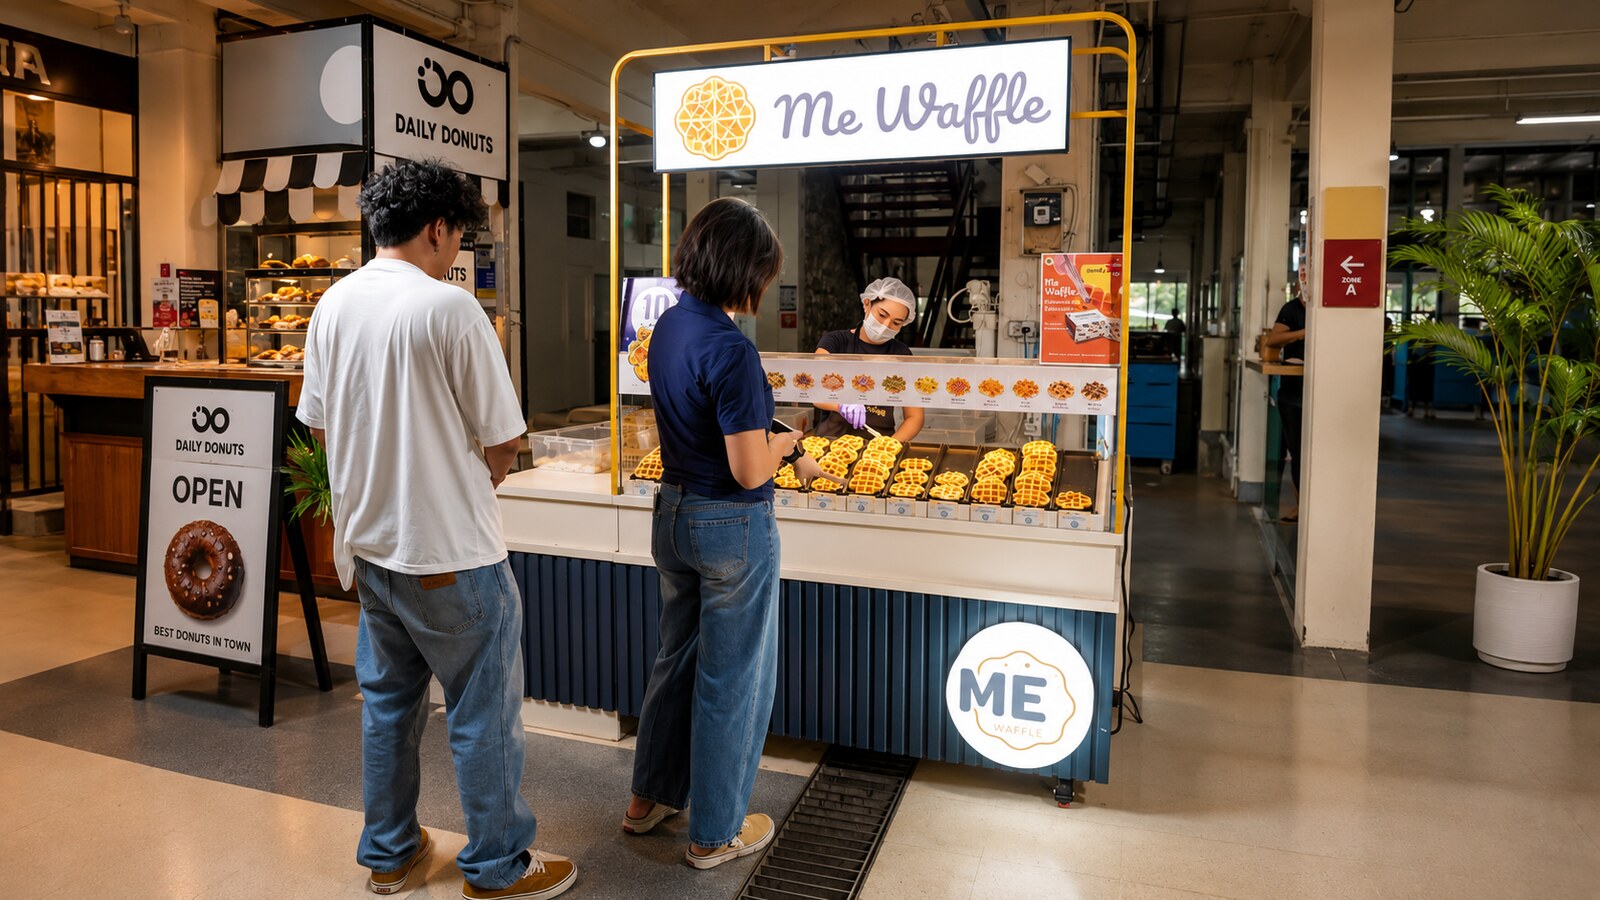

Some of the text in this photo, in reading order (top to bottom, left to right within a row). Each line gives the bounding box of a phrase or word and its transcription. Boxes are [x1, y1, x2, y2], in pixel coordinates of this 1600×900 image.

[773, 70, 1052, 145] Me Waffle
[395, 112, 493, 154] DAILY DONUTS
[443, 266, 467, 282] UTS
[1341, 276, 1362, 284] ZONE
[1345, 283, 1357, 296] A
[175, 438, 245, 456] DAILY DONUTS
[172, 475, 243, 509] OPEN
[154, 625, 251, 653] BEST DONUTS IN TOWN
[959, 668, 1047, 723] ME
[993, 723, 1042, 738] WAFFLE
